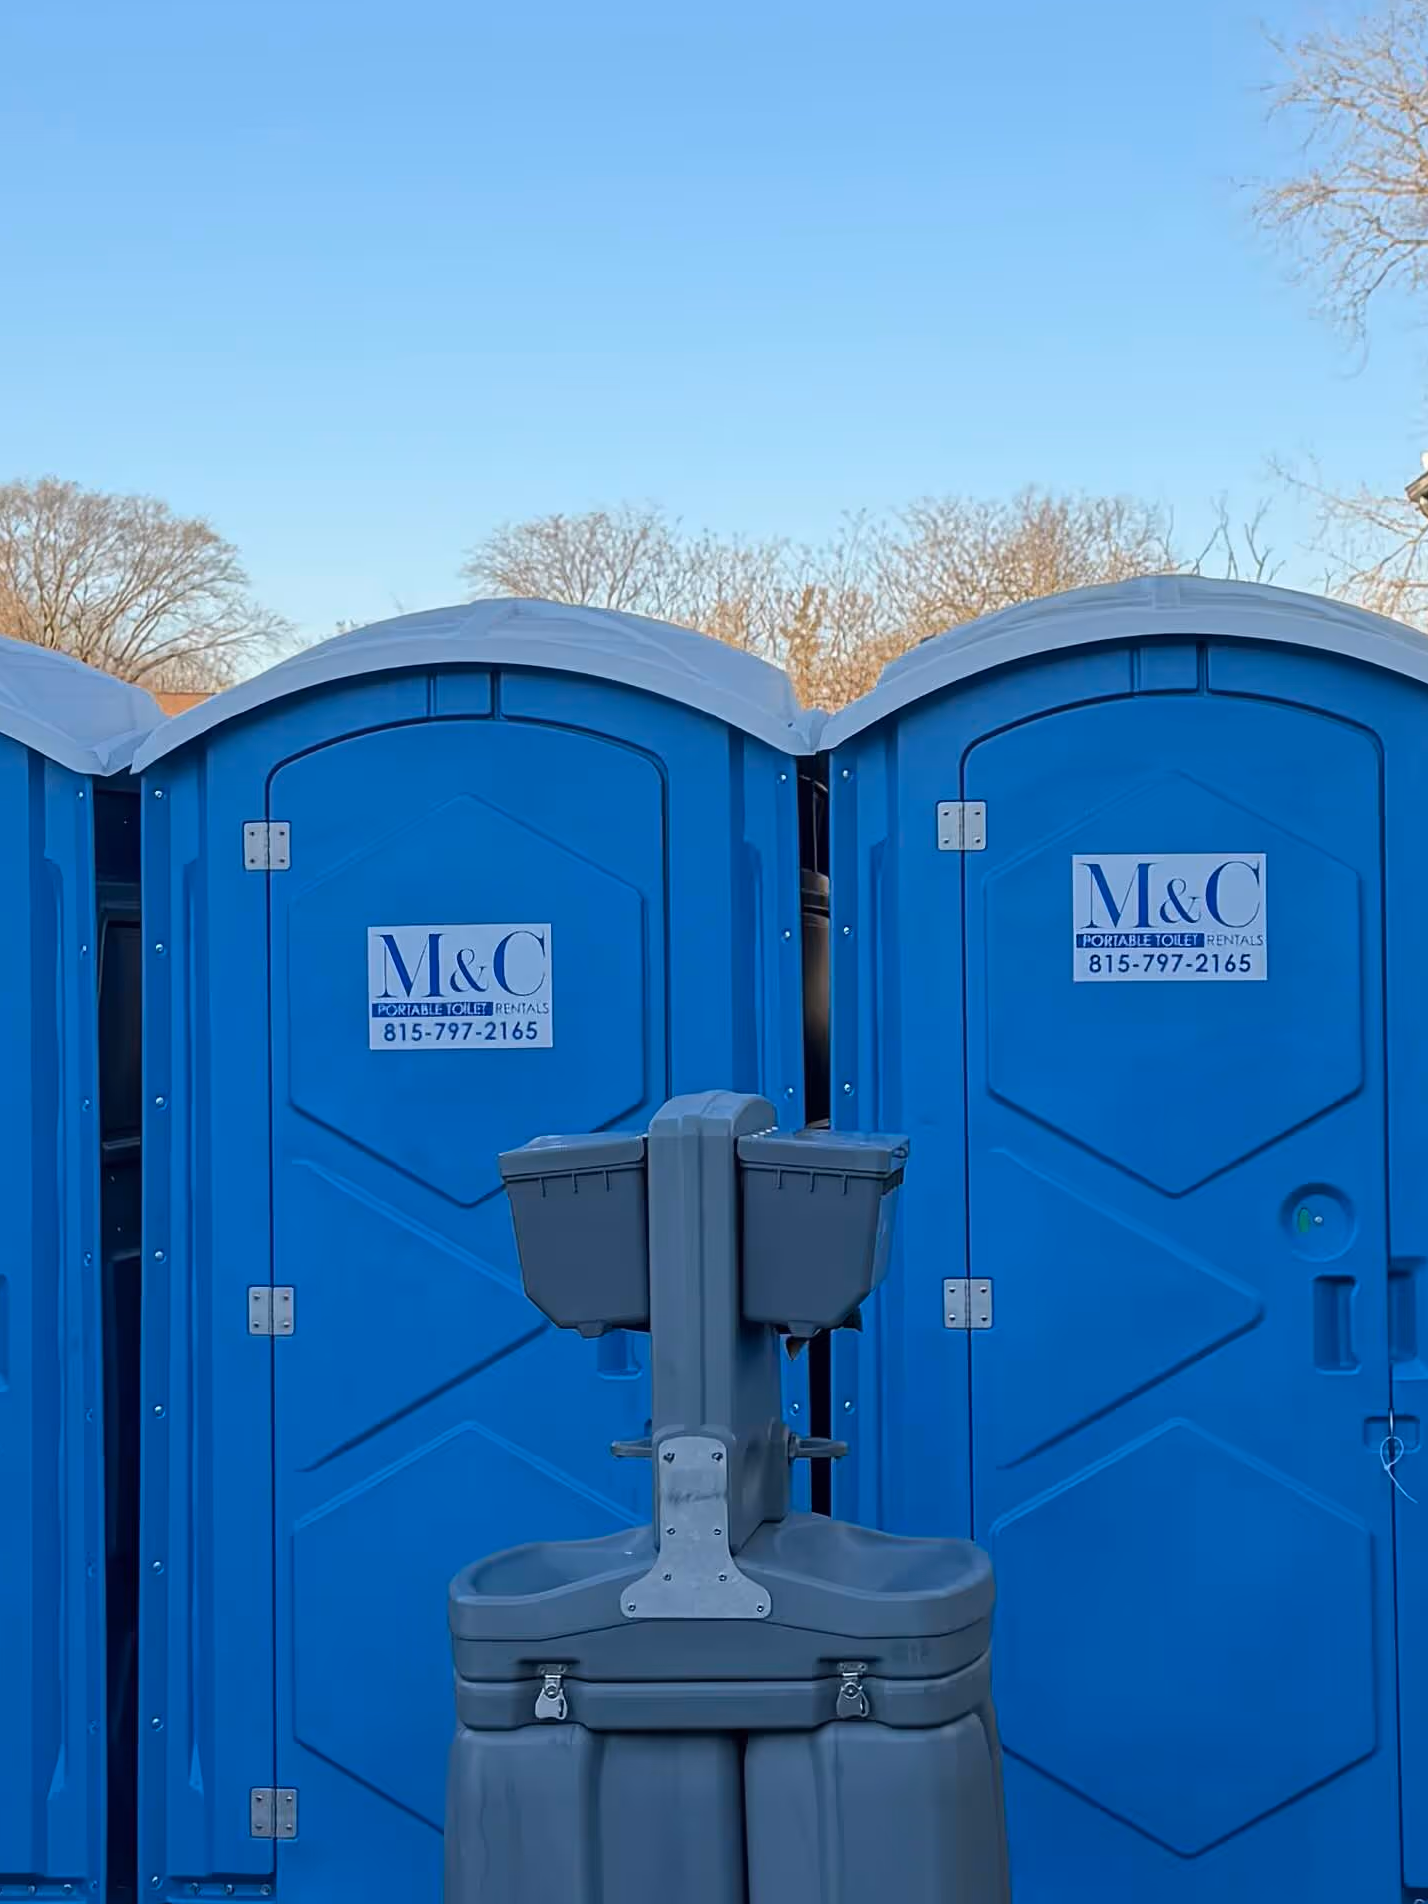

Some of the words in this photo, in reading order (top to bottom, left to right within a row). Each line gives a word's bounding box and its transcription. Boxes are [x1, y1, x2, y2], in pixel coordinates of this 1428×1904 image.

[1079, 860, 1261, 929] M&C
[1083, 934, 1152, 947] PORTABLE
[1155, 934, 1198, 947] TOILET
[1206, 934, 1264, 946] RENTALS
[375, 930, 546, 998] M&C
[1088, 953, 1252, 973] 815-797-2165
[377, 1003, 442, 1016] PORTABLE
[446, 1002, 487, 1015] TOILET
[495, 1002, 550, 1015] RENTALS
[383, 1021, 538, 1041] 815-797-2165
